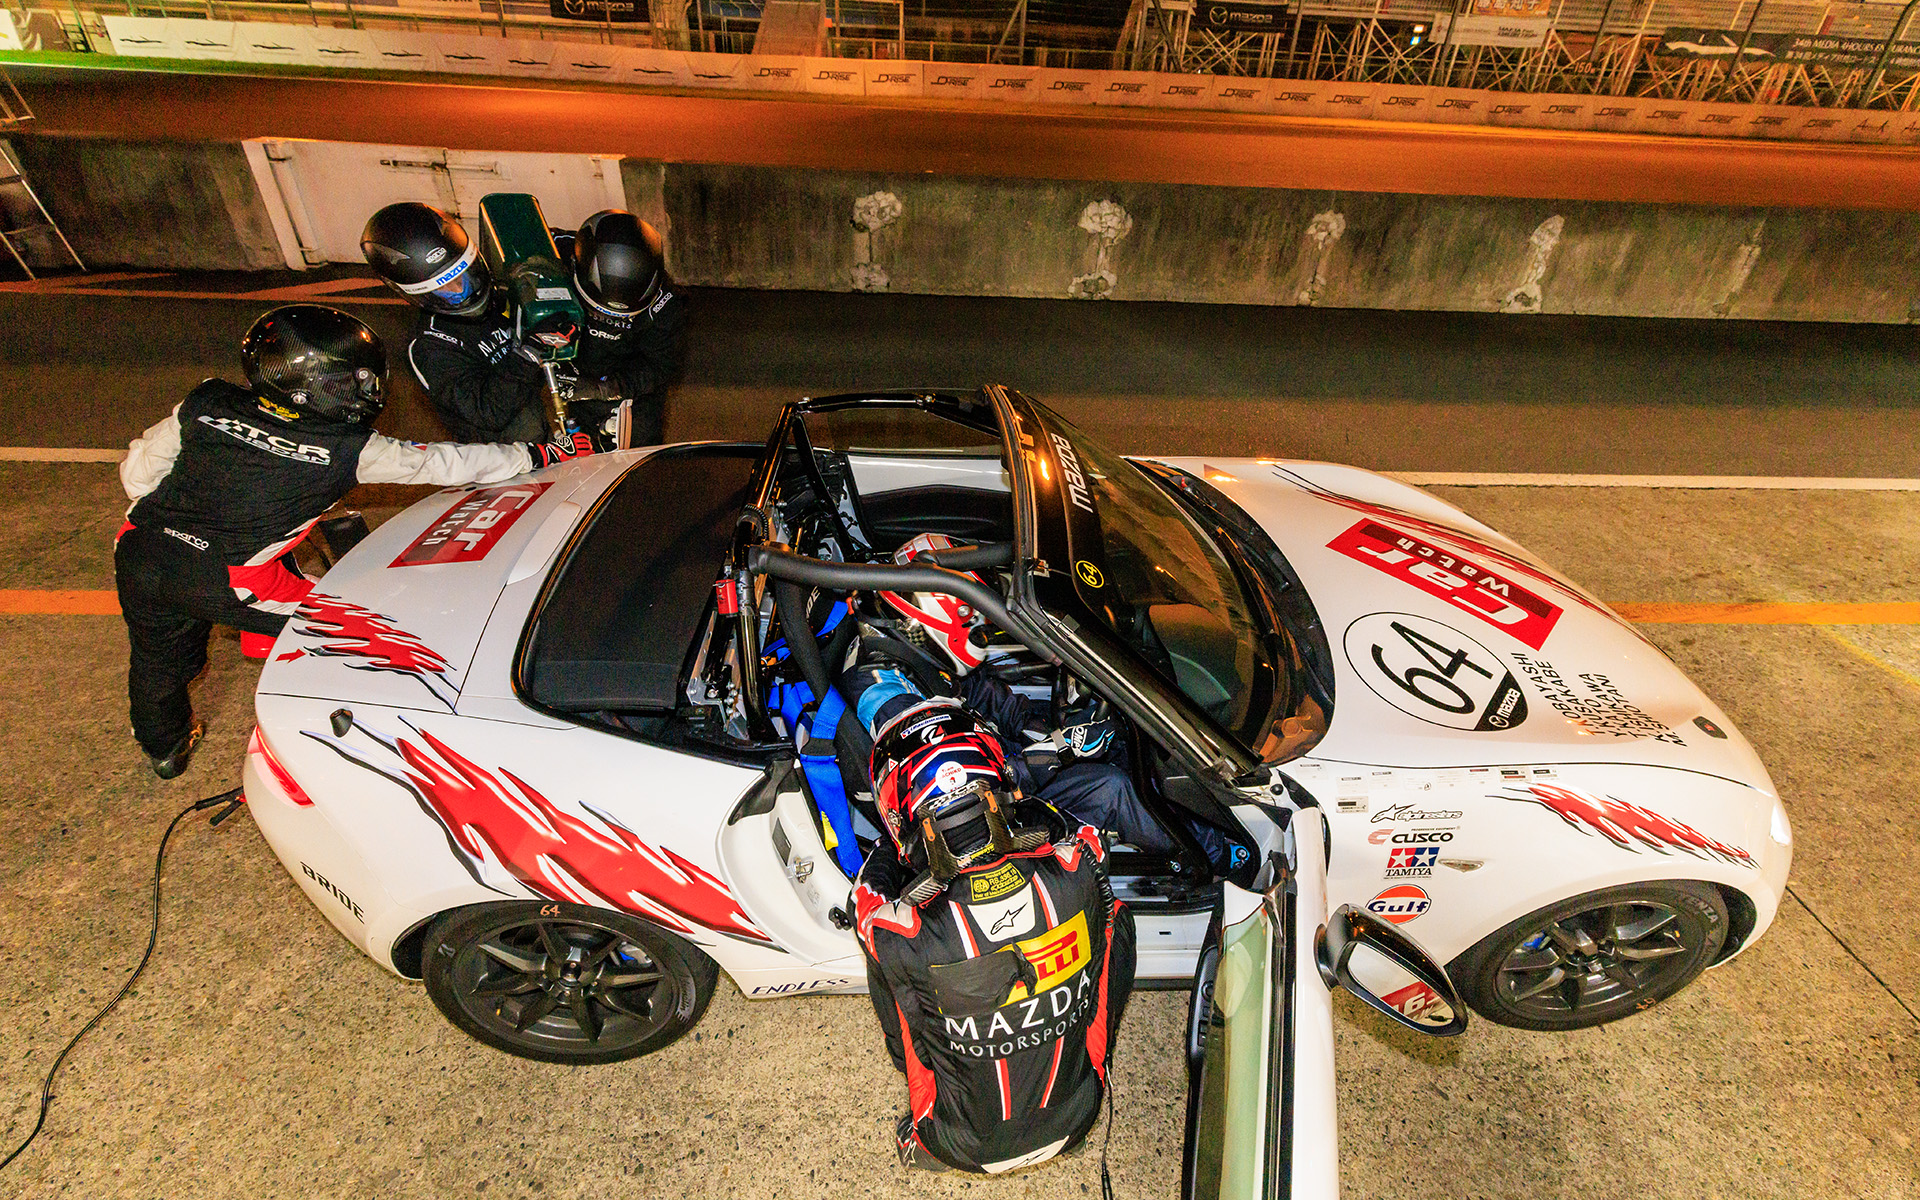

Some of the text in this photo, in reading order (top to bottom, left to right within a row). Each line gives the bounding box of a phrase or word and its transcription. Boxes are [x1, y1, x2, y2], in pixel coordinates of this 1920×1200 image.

[1230, 11, 1273, 23] mazda
[1812, 39, 1839, 49] MEDIA
[436, 260, 468, 286] mazda
[240, 422, 330, 460] TCR
[1051, 433, 1093, 513] mazda
[163, 527, 209, 550] sparco
[422, 499, 488, 546] Watch
[453, 490, 535, 552] Car
[1083, 563, 1097, 586] 64
[1357, 546, 1529, 625] Car
[1396, 537, 1509, 597] Watch
[1371, 621, 1493, 714] 64
[1496, 687, 1521, 718] mazda
[1511, 652, 1605, 736] T.KOBAYASHI
[1535, 660, 1628, 738] Y.KUSAKABE
[1391, 832, 1454, 844] CUSCO
[1385, 867, 1432, 877] TAMIYA
[300, 861, 365, 925] BRIDE
[540, 904, 560, 917] 64
[1367, 901, 1429, 913] Gulf
[751, 978, 850, 995] ENDLESS
[945, 969, 1091, 1040] MAZDA
[950, 994, 1089, 1058] MOTORSPORTS
